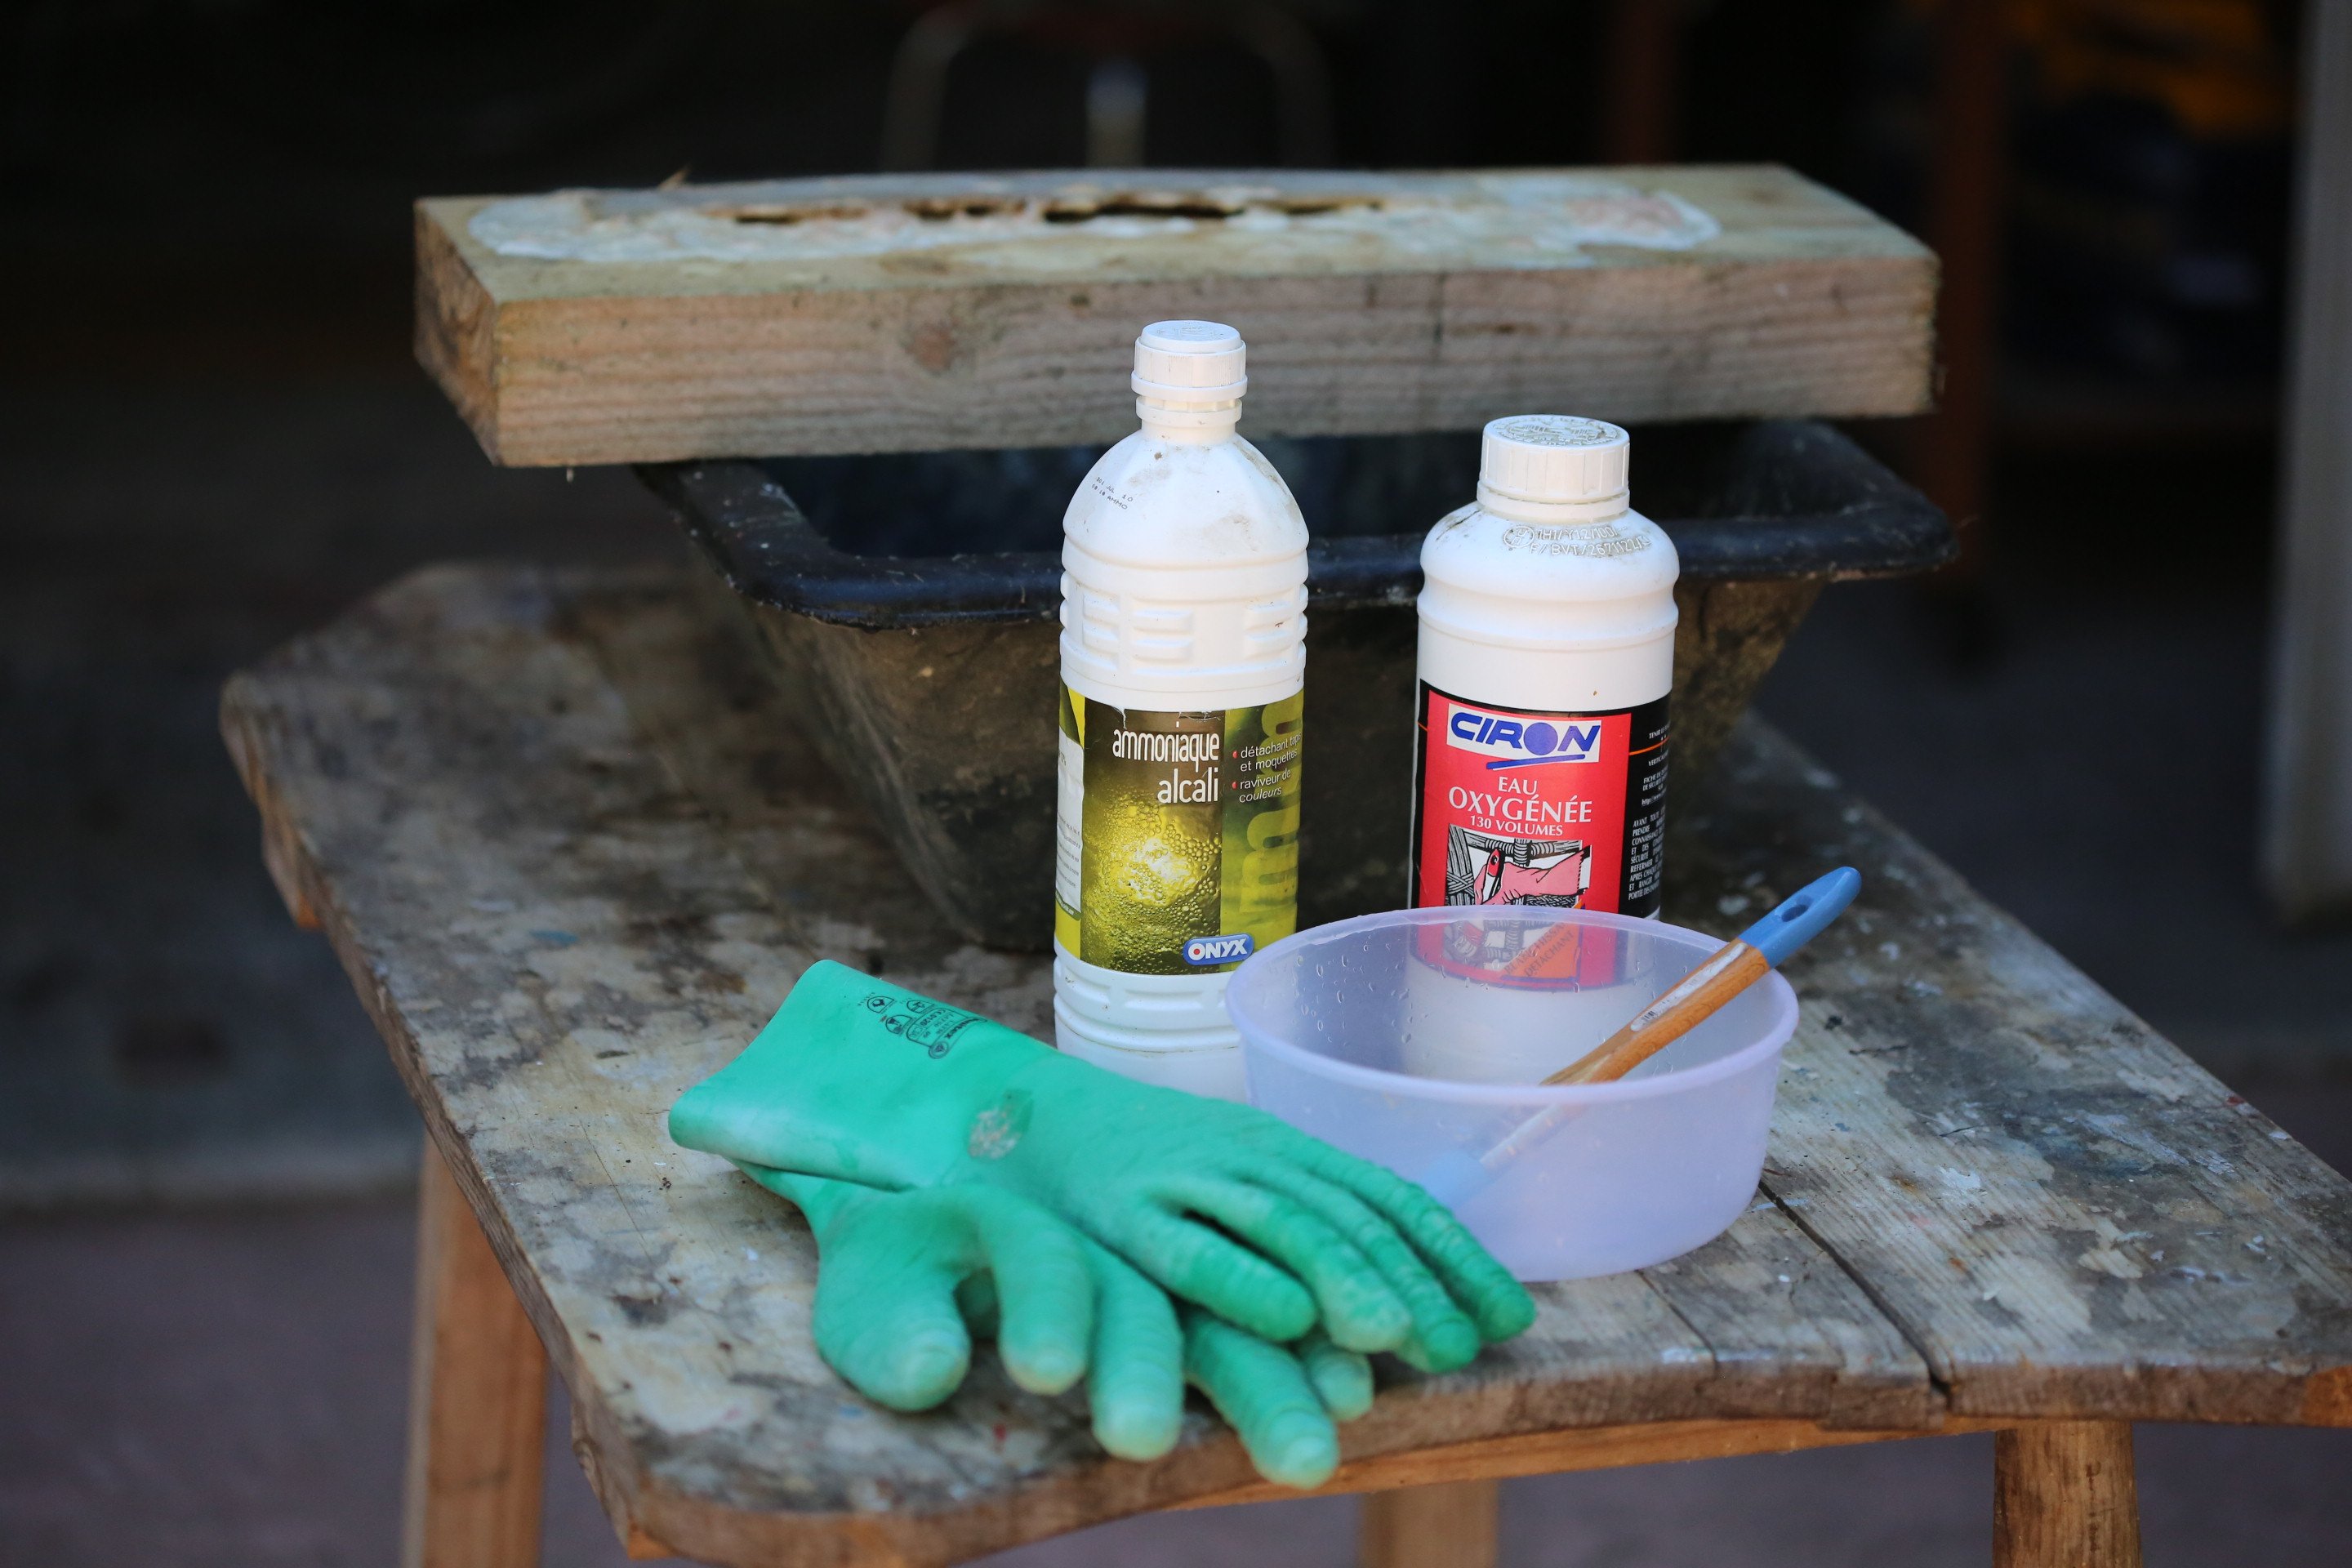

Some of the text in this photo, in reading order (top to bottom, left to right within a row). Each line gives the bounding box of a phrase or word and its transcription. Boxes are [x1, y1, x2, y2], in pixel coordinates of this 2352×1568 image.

[1450, 712, 1601, 756] CIRON
[1112, 722, 1220, 773] ammoniaque
[1241, 740, 1289, 759] détachant
[1240, 748, 1298, 772] et moquettes
[1157, 767, 1218, 804] alcali
[1240, 768, 1291, 790] raviveur de
[1499, 776, 1538, 796] EAU
[1239, 786, 1282, 803] couleurs
[1449, 786, 1592, 823] OXYGÉNÉE
[1470, 815, 1564, 837] 130 VOLUMES
[1187, 938, 1248, 961] ONYX
